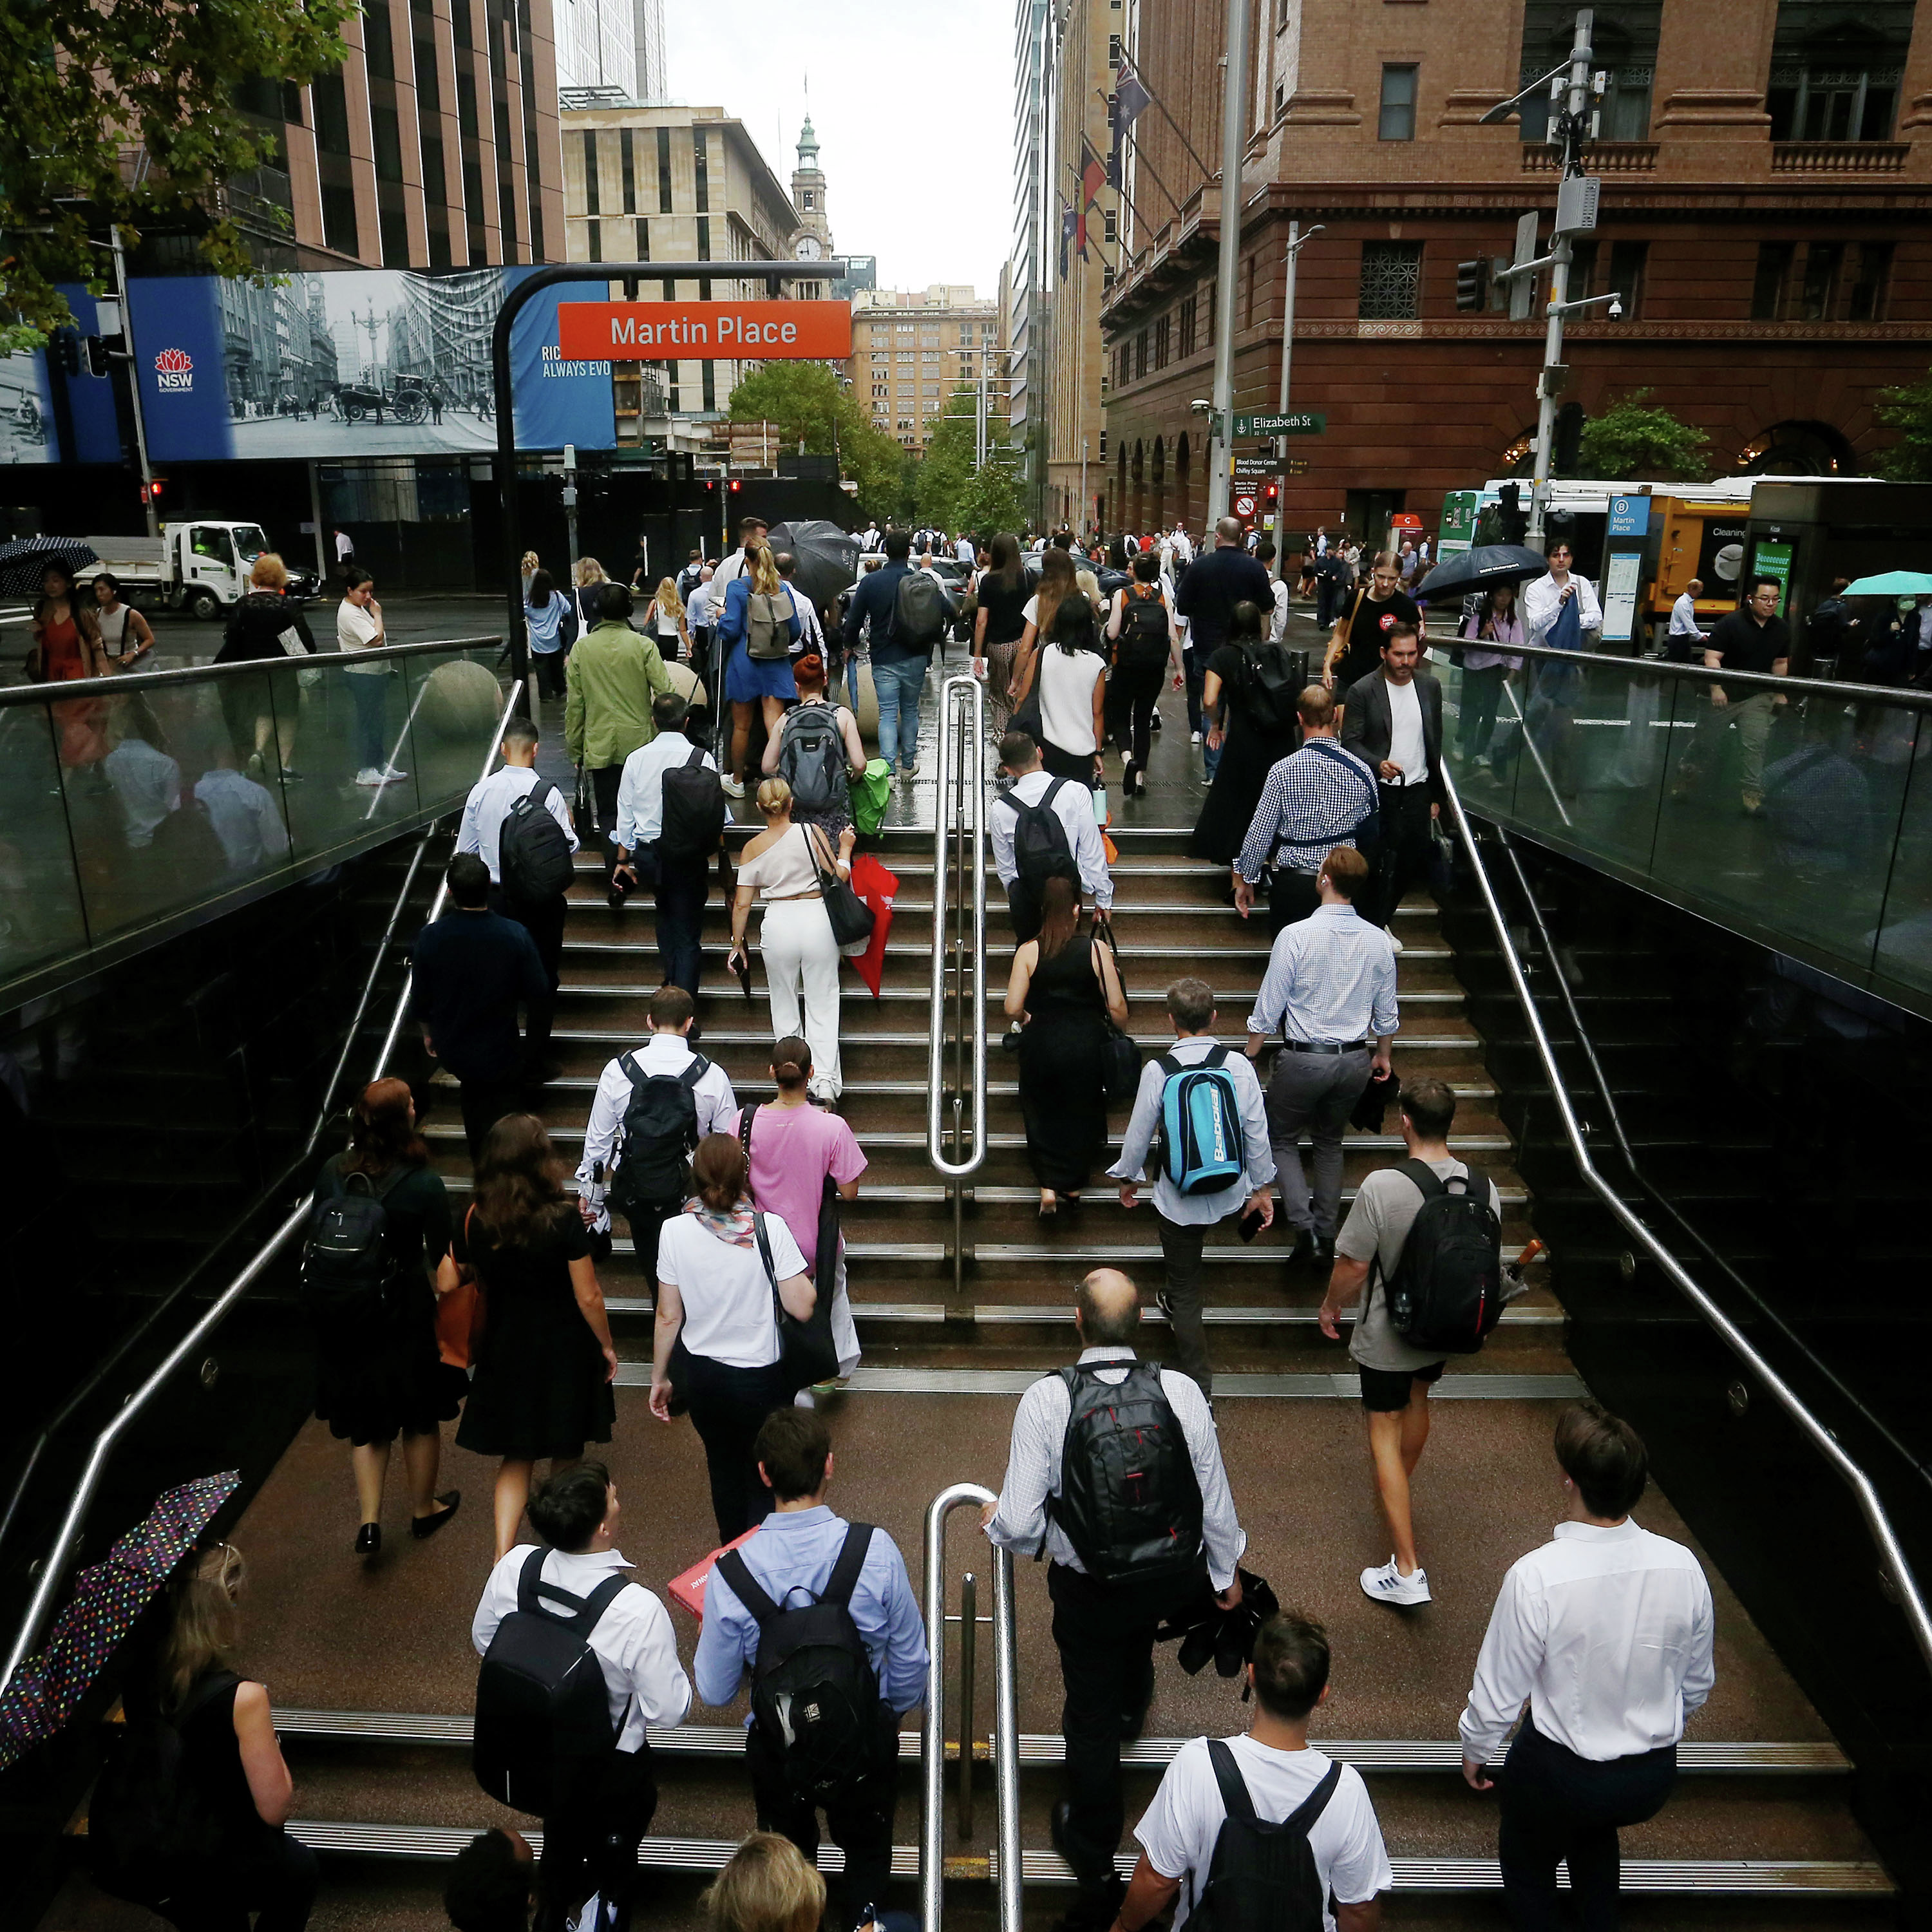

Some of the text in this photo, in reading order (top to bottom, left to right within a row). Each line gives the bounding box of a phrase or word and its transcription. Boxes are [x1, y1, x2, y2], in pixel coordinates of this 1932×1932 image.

[611, 316, 797, 345] Martin Place
[542, 345, 561, 361] RIC
[543, 361, 611, 377] ALWAYS EVO
[157, 374, 193, 387] NSW
[1253, 415, 1311, 428] Elizabeth St
